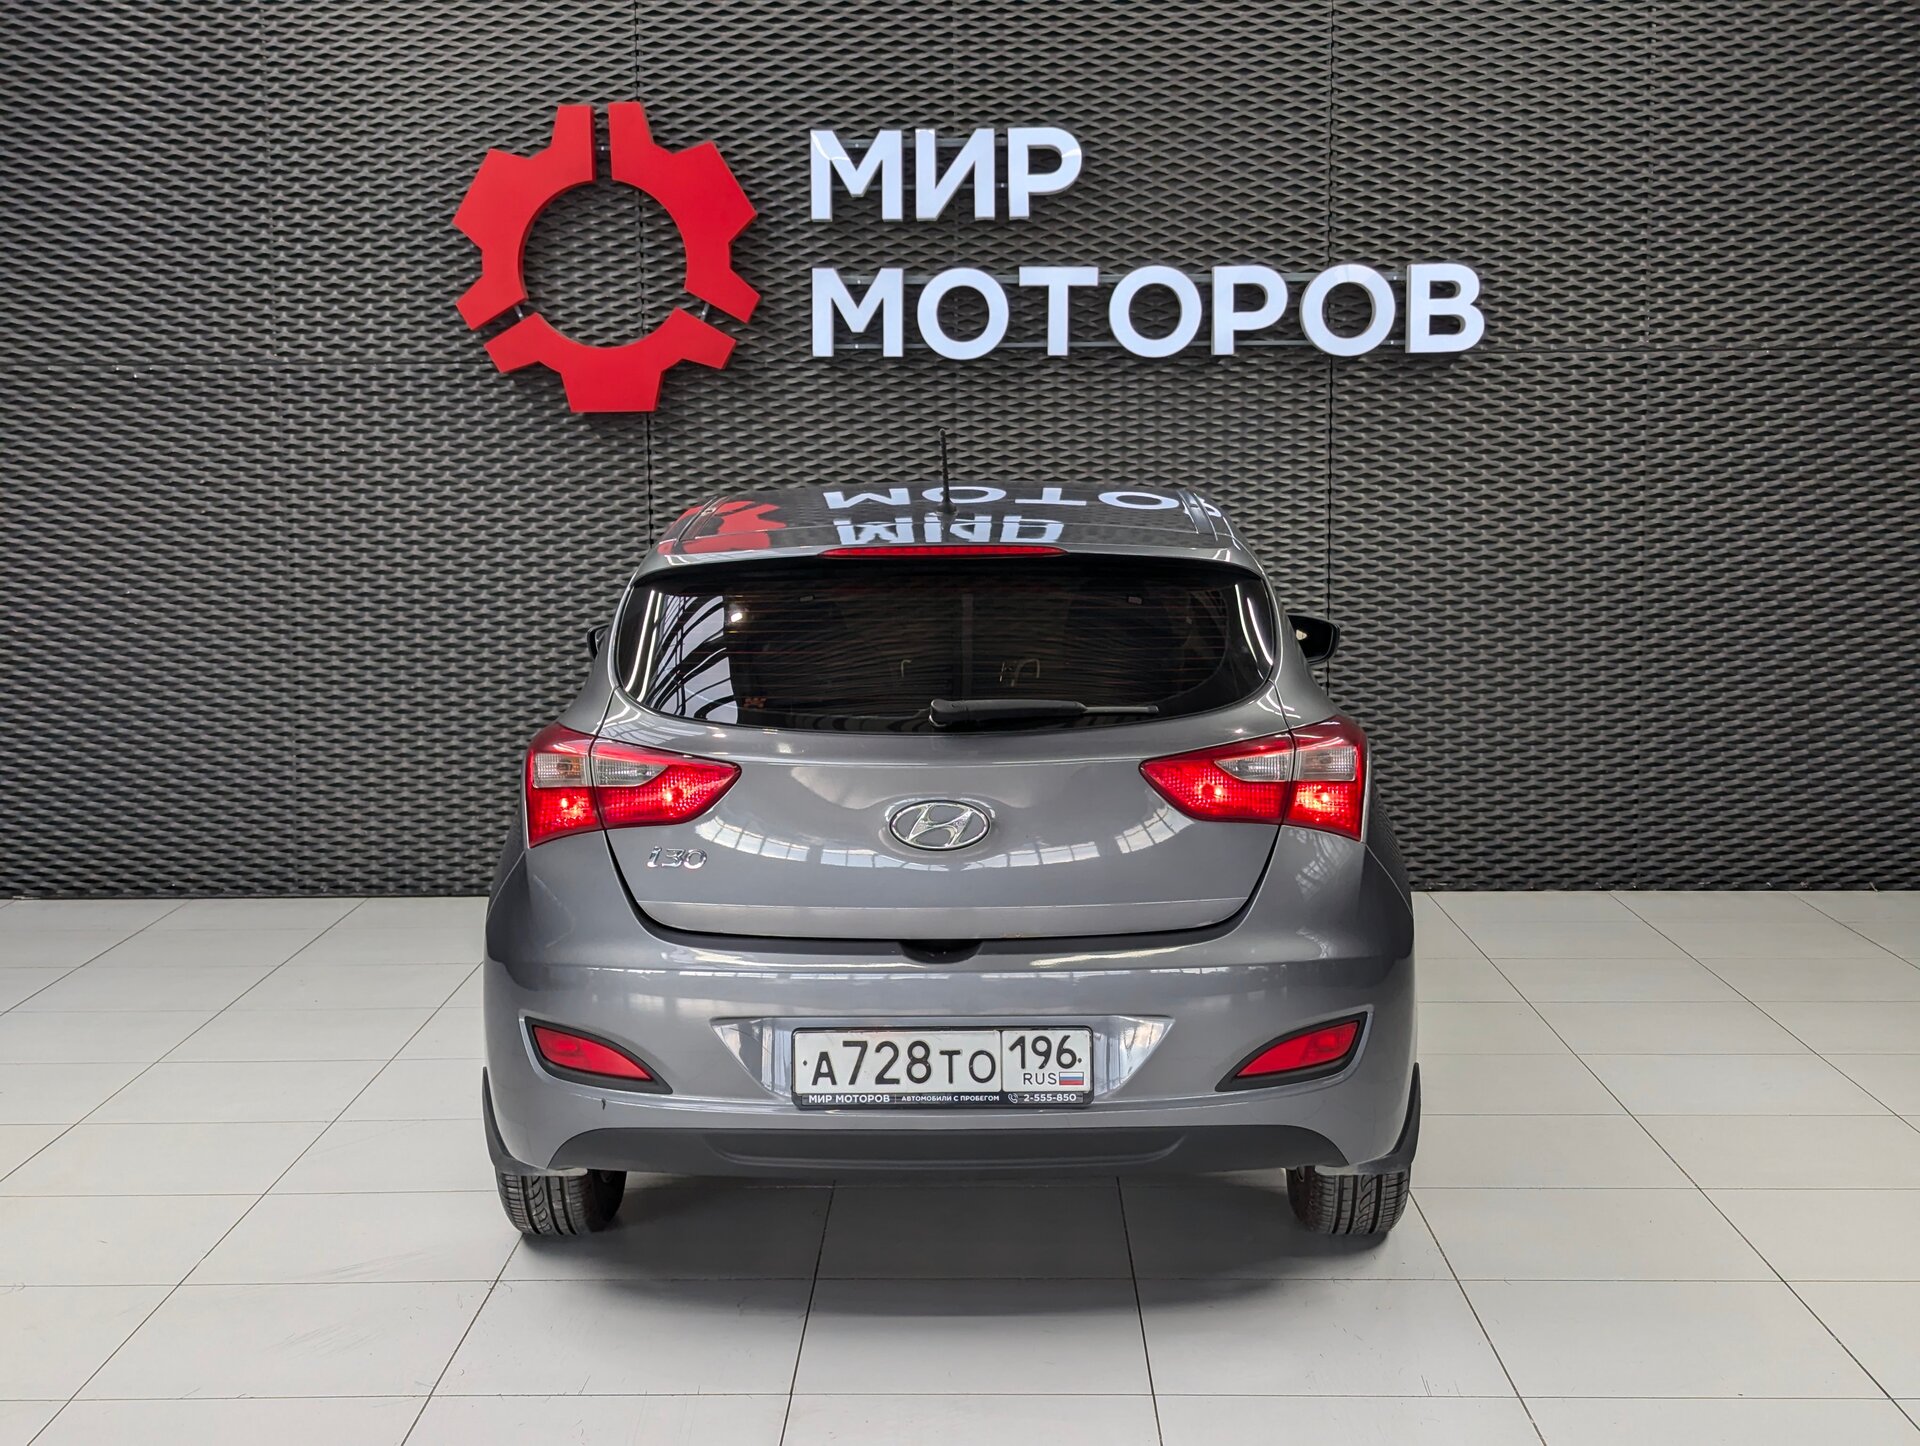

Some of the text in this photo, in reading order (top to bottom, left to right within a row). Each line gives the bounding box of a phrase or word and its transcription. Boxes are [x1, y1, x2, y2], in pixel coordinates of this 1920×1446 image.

[810, 126, 1083, 222] МИР
[811, 262, 1486, 360] МОТОРОВ
[646, 846, 708, 870] i30
[1008, 1035, 1078, 1070] 196
[1023, 1072, 1057, 1085] RUS
[808, 1094, 890, 1104] МИР МОТОРОВ
[1023, 1093, 1077, 1102] 2-555-850
